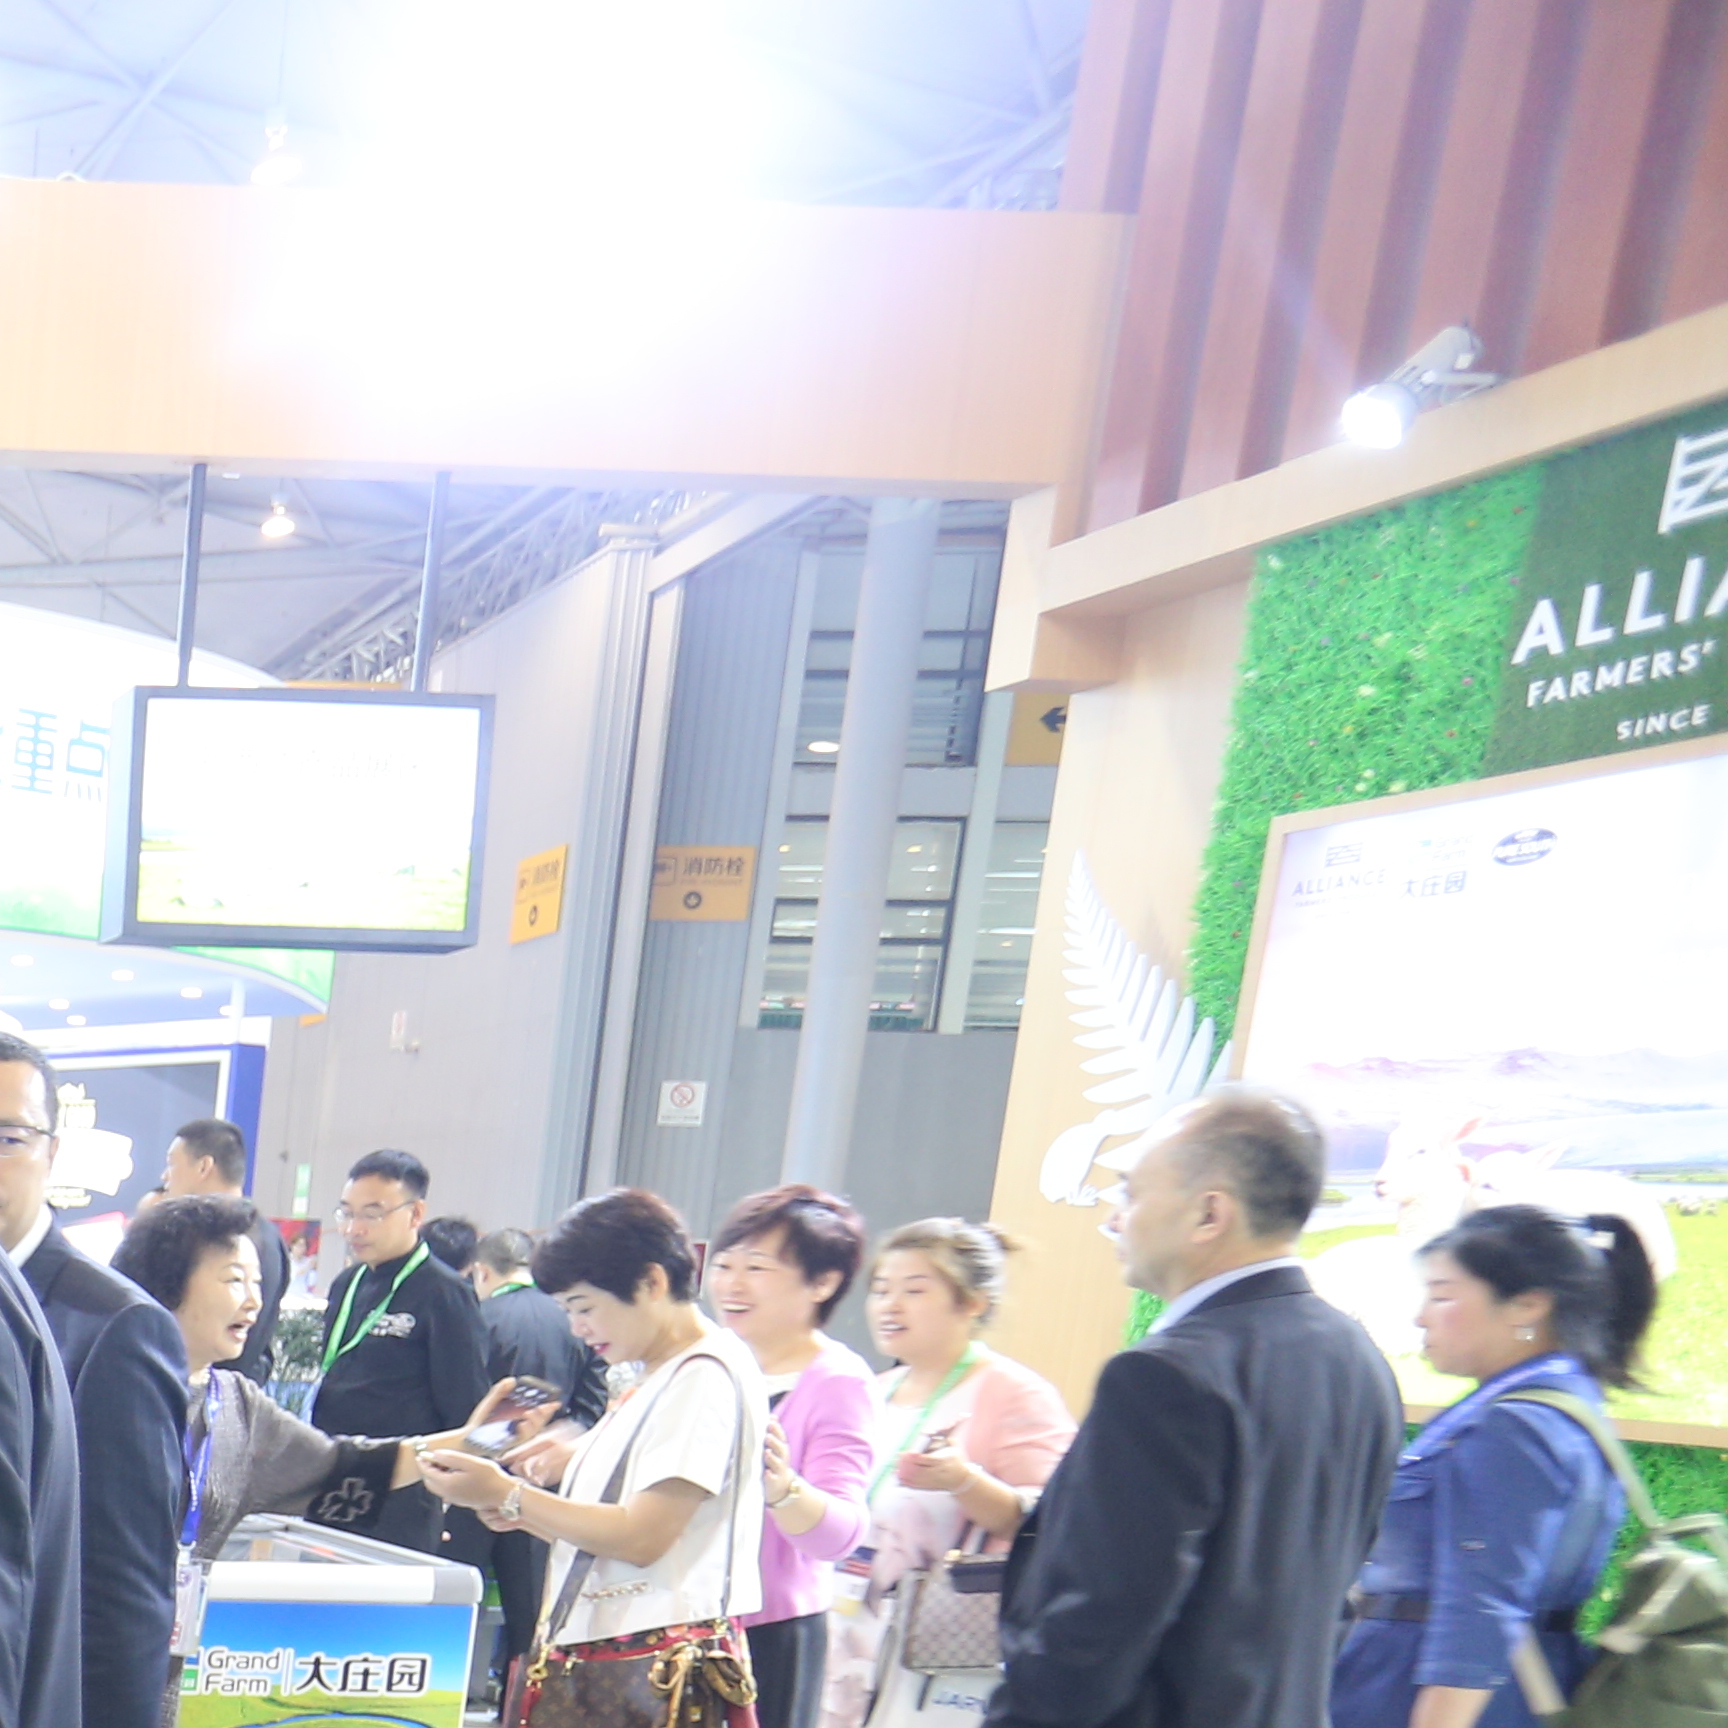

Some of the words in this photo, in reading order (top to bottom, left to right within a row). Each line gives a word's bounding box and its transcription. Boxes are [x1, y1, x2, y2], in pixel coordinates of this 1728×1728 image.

[1616, 703, 1711, 742] SINCE
[682, 856, 745, 876] 消防栓
[1291, 868, 1386, 897] ALLIANCE
[1400, 869, 1468, 899] 大庄园
[207, 1649, 280, 1671] Grand
[296, 1656, 427, 1693] 大庄园
[204, 1672, 268, 1694] Farm
